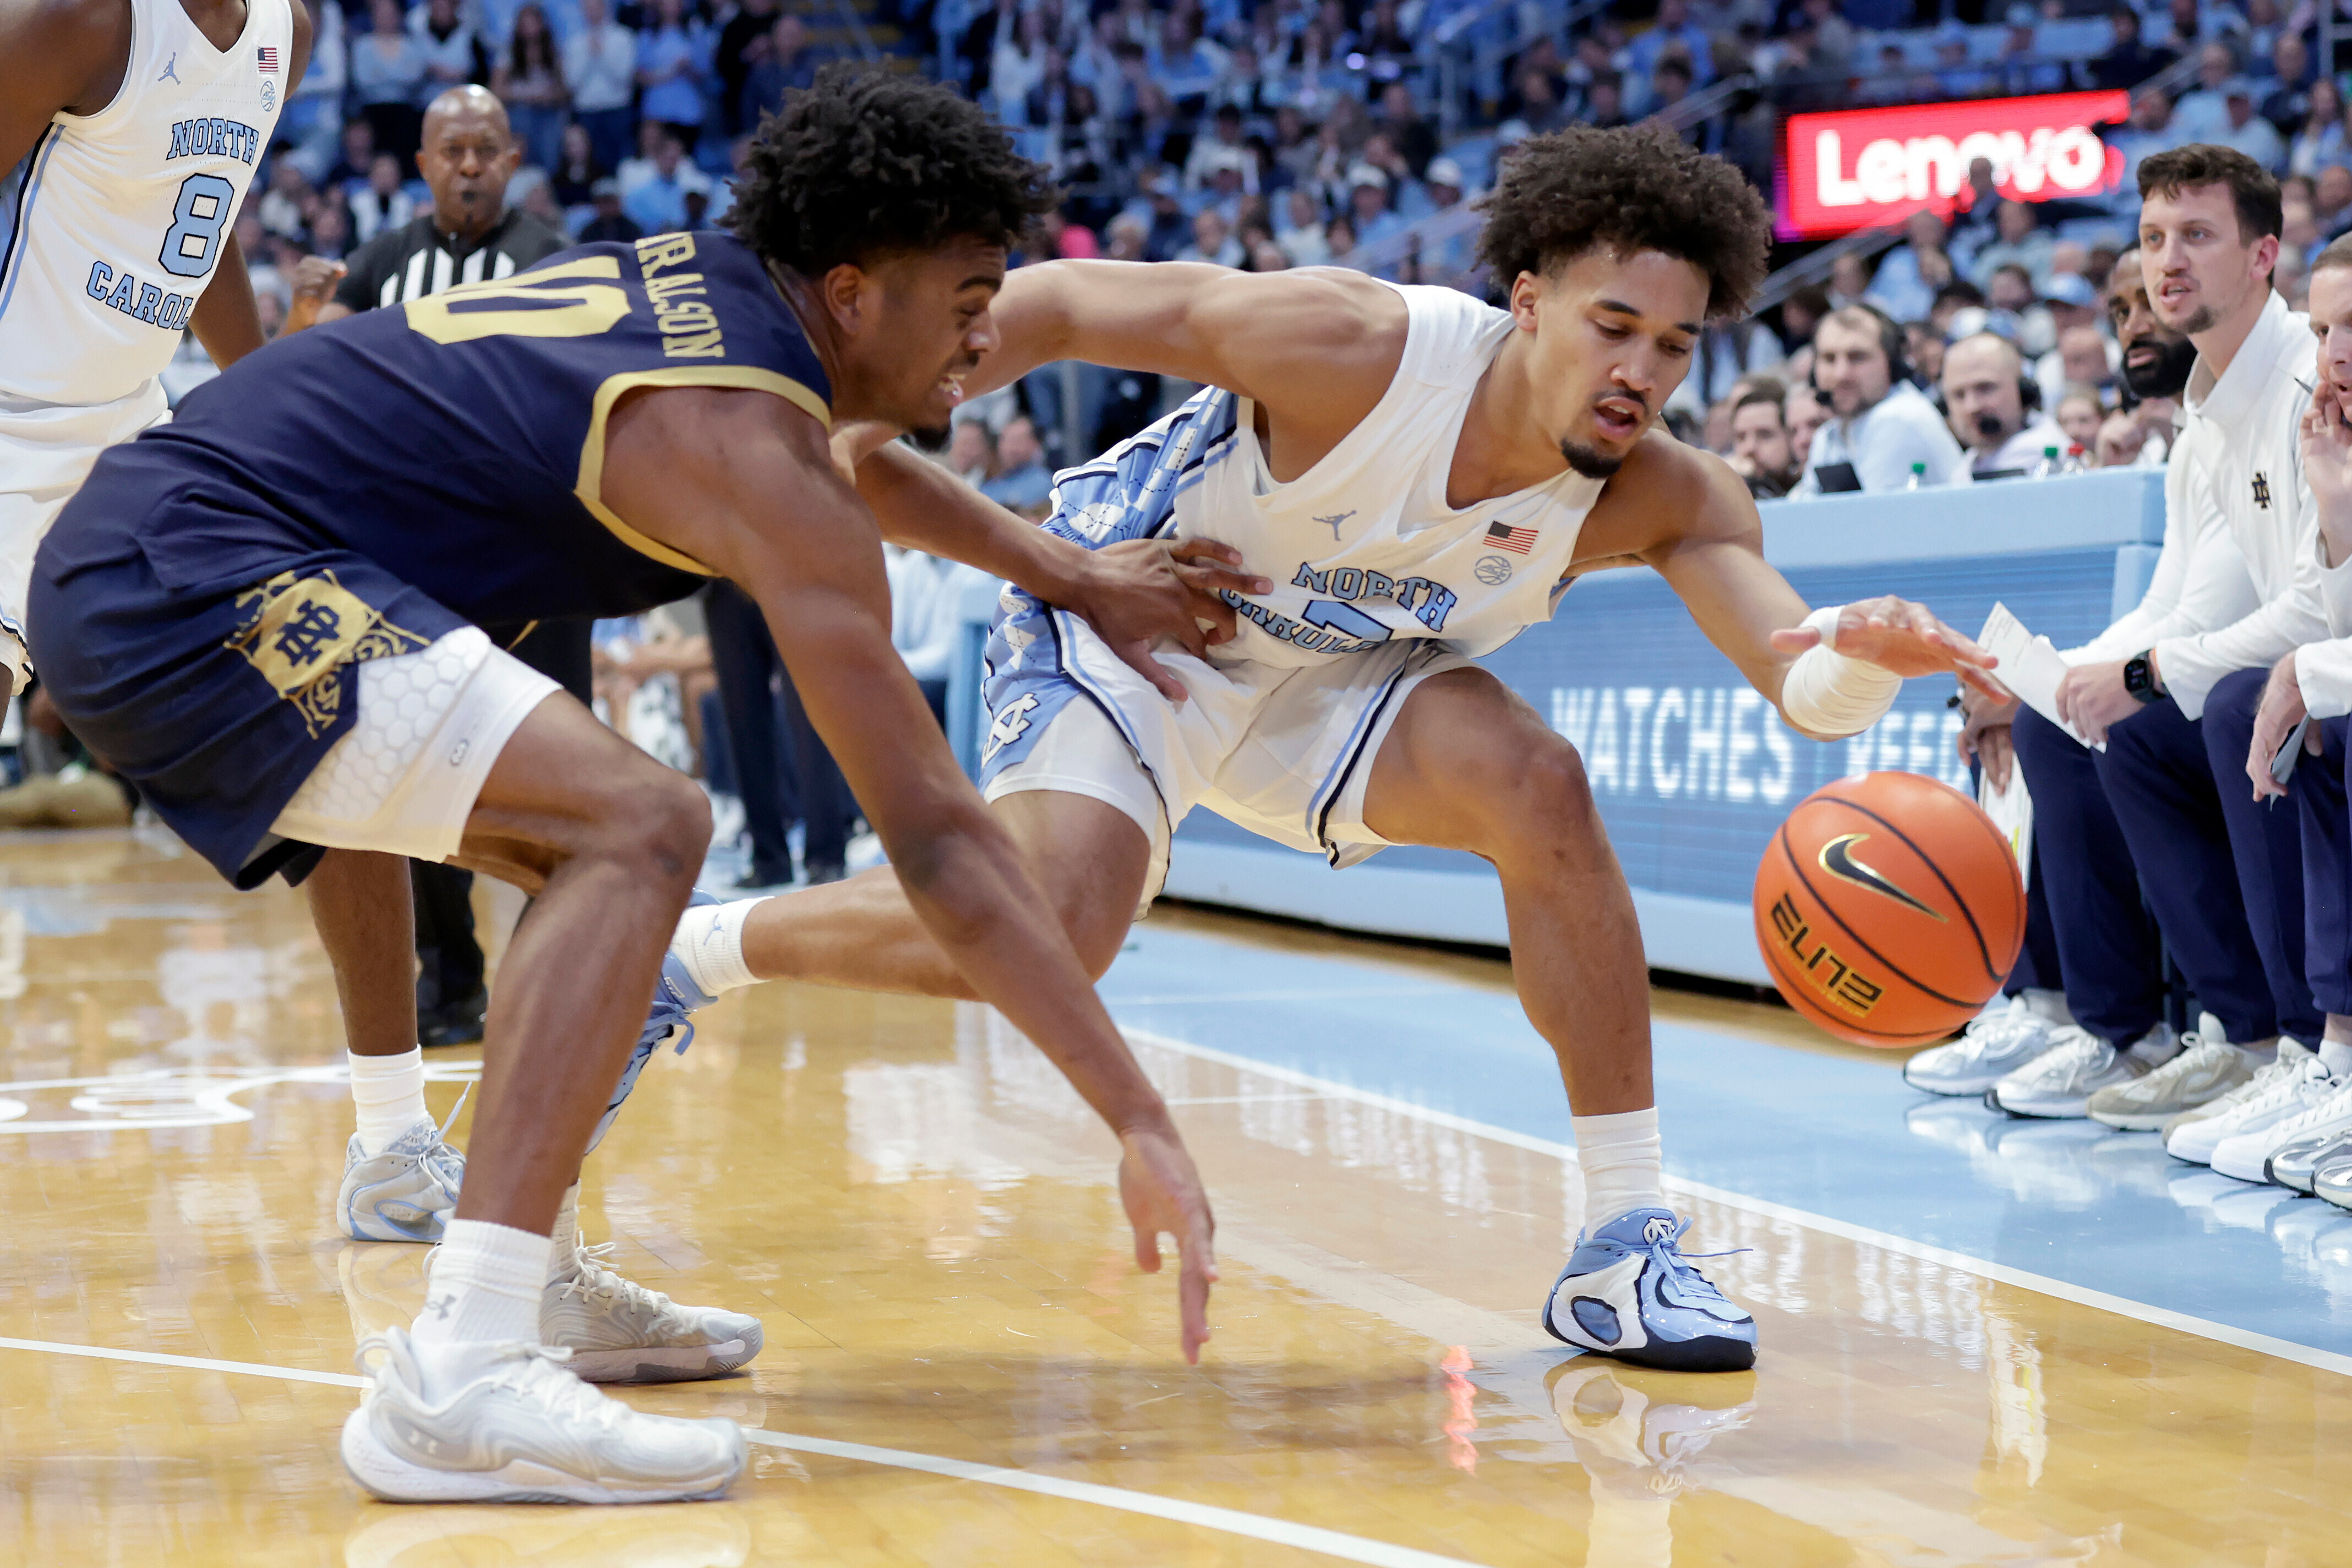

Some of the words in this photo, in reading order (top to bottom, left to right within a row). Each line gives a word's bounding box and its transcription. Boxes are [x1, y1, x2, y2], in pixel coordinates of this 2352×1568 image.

[166, 118, 259, 167] NORTH
[1815, 124, 2105, 207] Lenovo
[158, 172, 235, 278] 8
[1290, 561, 1458, 633] NORTH
[1551, 687, 1793, 805] WATCHES
[1770, 892, 1884, 1010] ELITE
